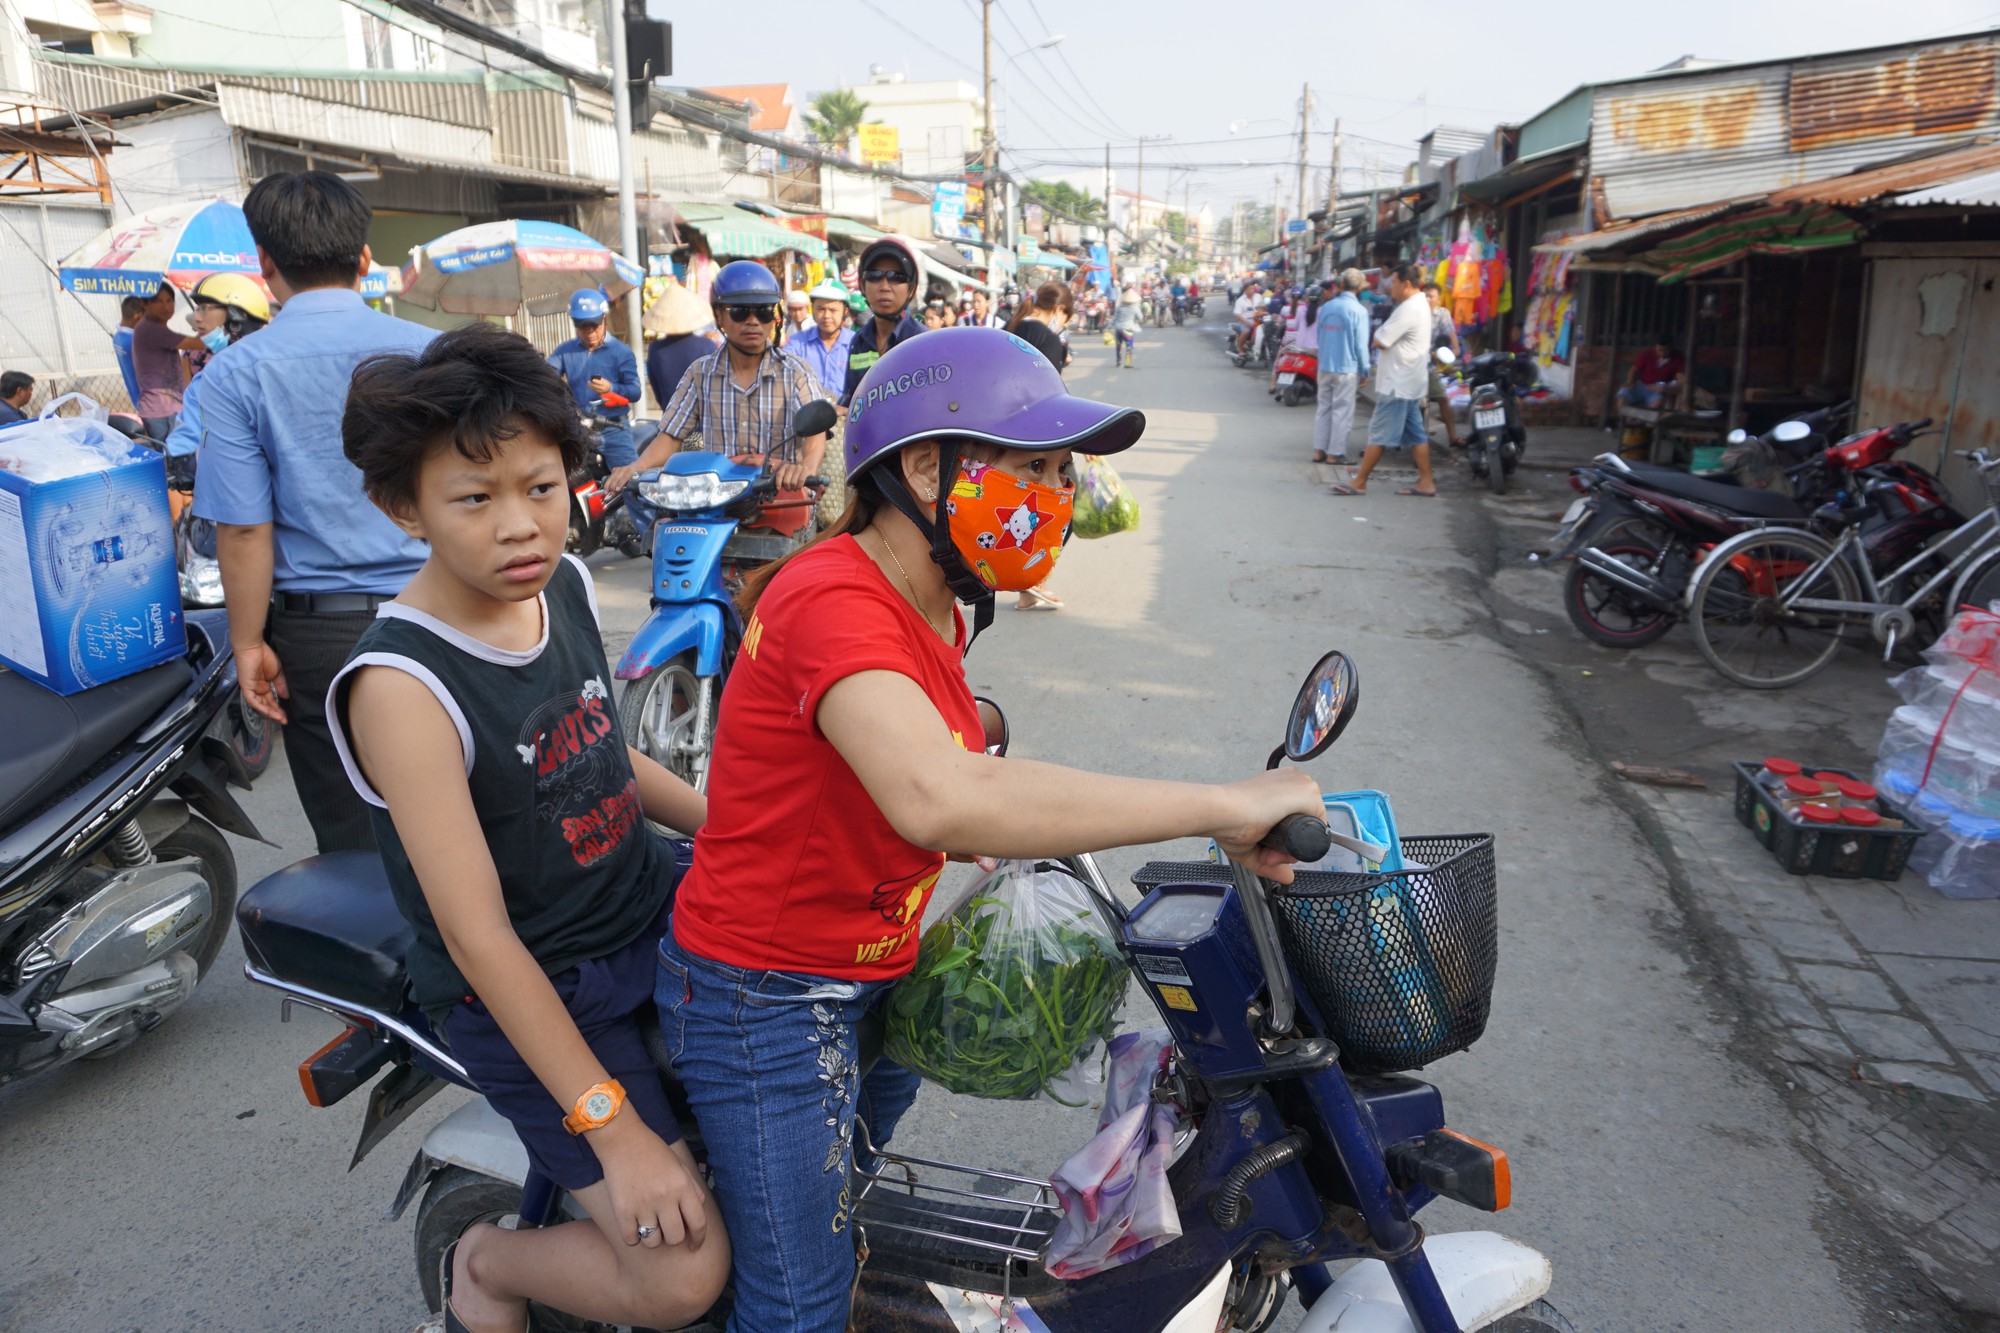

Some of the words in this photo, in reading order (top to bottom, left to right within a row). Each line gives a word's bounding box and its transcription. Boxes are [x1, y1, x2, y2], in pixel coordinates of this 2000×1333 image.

[176, 251, 259, 265] mobifo
[441, 257, 460, 269] SIM
[73, 277, 97, 291] SIM
[138, 278, 158, 294] TÀI
[867, 364, 953, 409] PIAGGIO
[665, 526, 708, 535] HONDA
[149, 602, 165, 648] AQUAFINA
[561, 808, 602, 843] SAN
